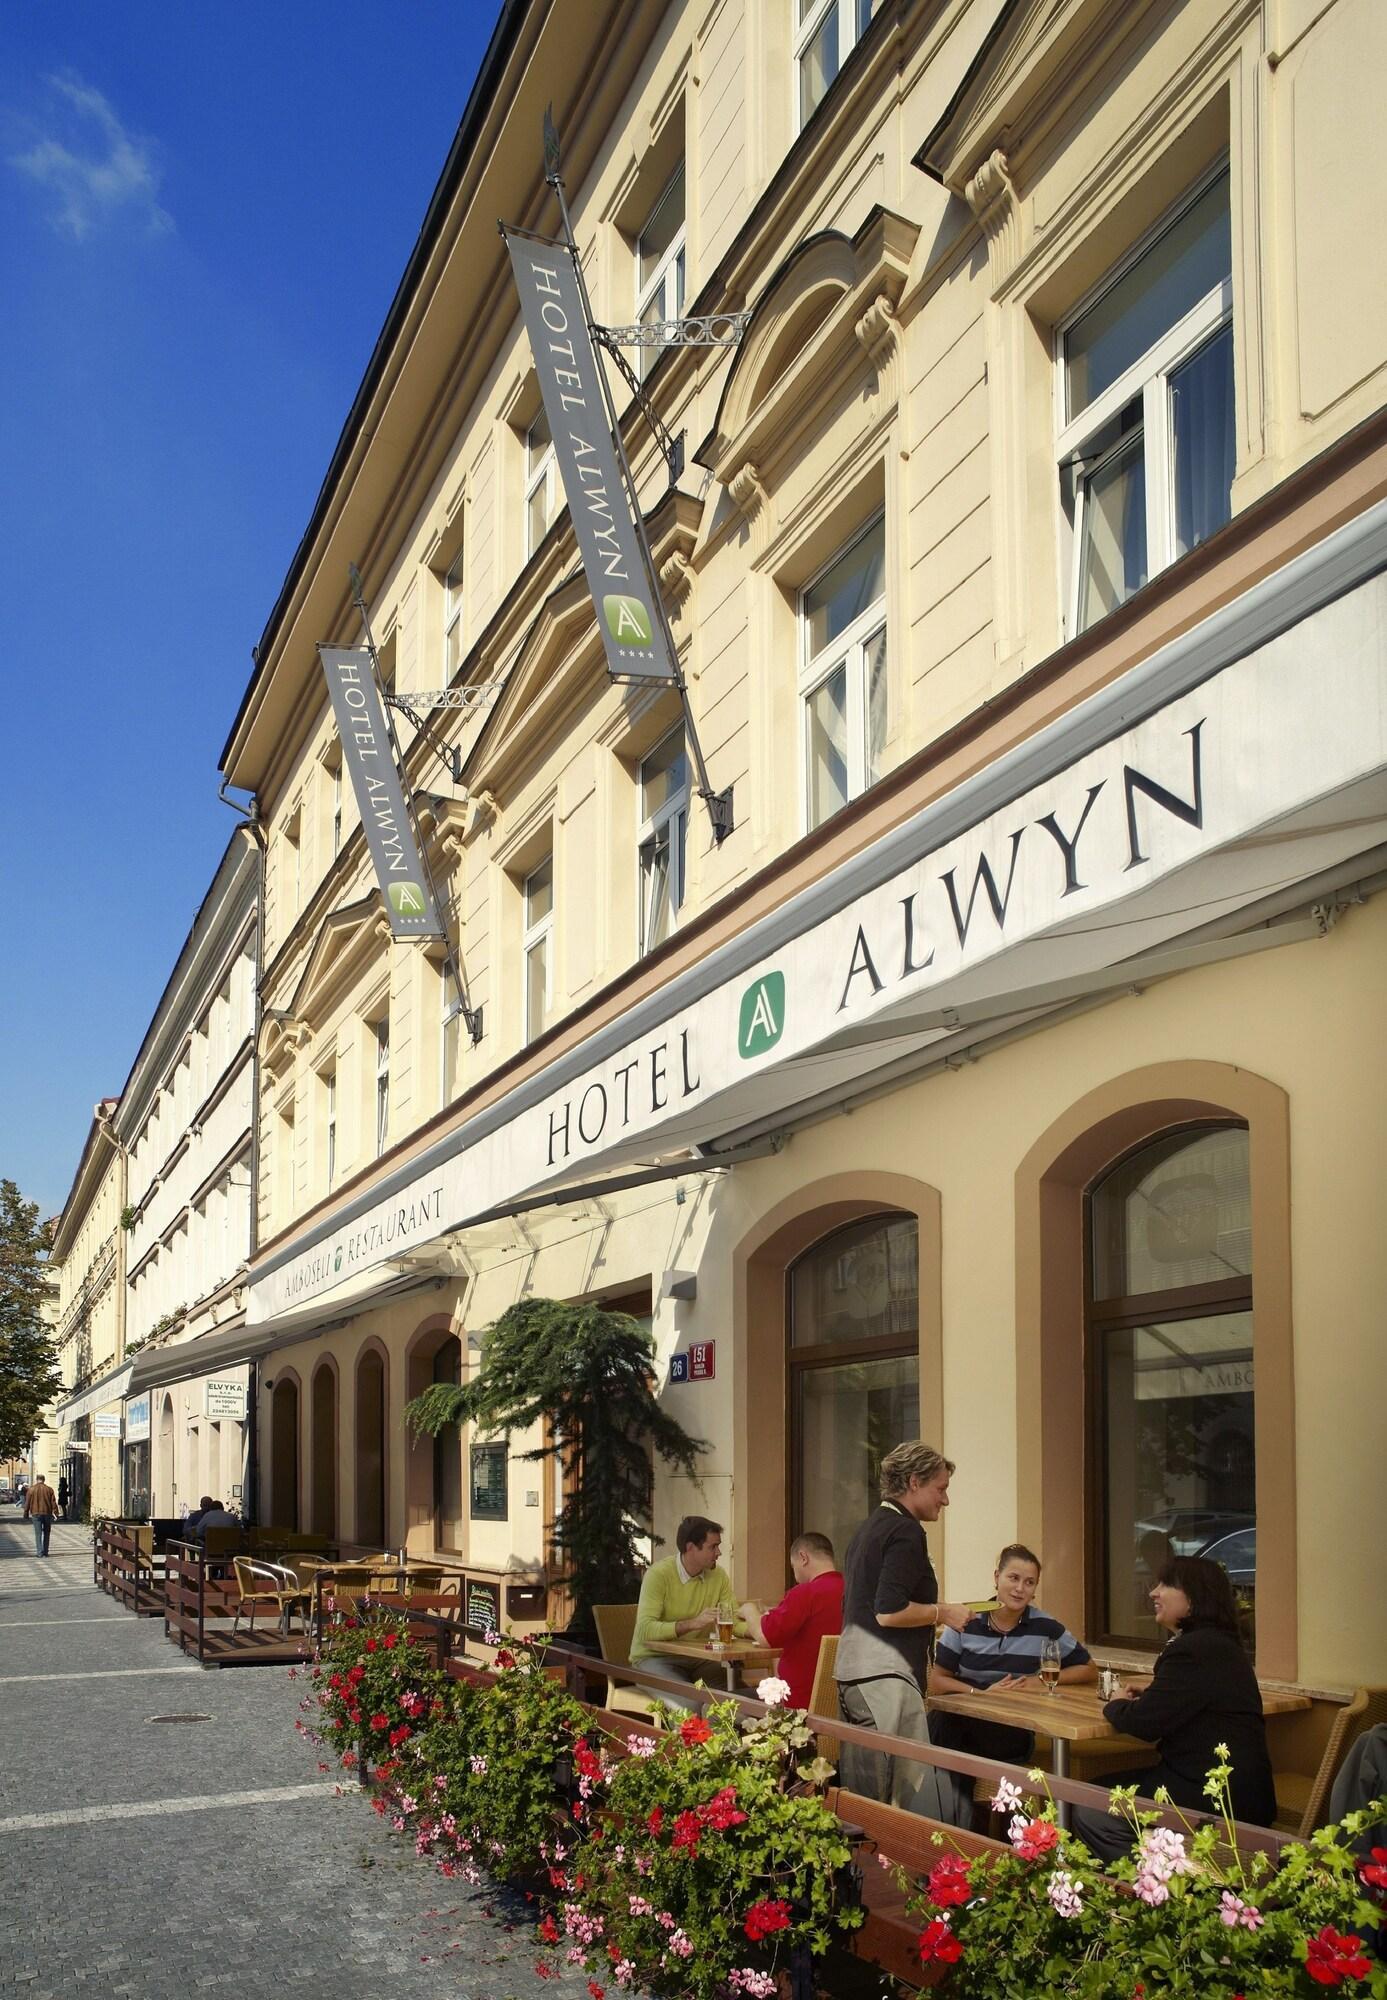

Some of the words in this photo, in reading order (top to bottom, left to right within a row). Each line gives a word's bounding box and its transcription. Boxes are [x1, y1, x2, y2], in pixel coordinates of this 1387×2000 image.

[531, 262, 587, 413] HOTEL
[568, 432, 630, 580] ALWYN
[337, 663, 378, 762] HOTEL
[365, 775, 409, 872] ALWYN
[545, 1027, 701, 1167] HOTEL
[835, 716, 1209, 1014] ALWYN
[284, 1254, 331, 1298] AMBOSELI
[347, 1187, 444, 1264] RESTAURANT
[208, 1383, 243, 1391] ELVYKA
[672, 1360, 683, 1377] 26
[693, 1346, 706, 1363] 151
